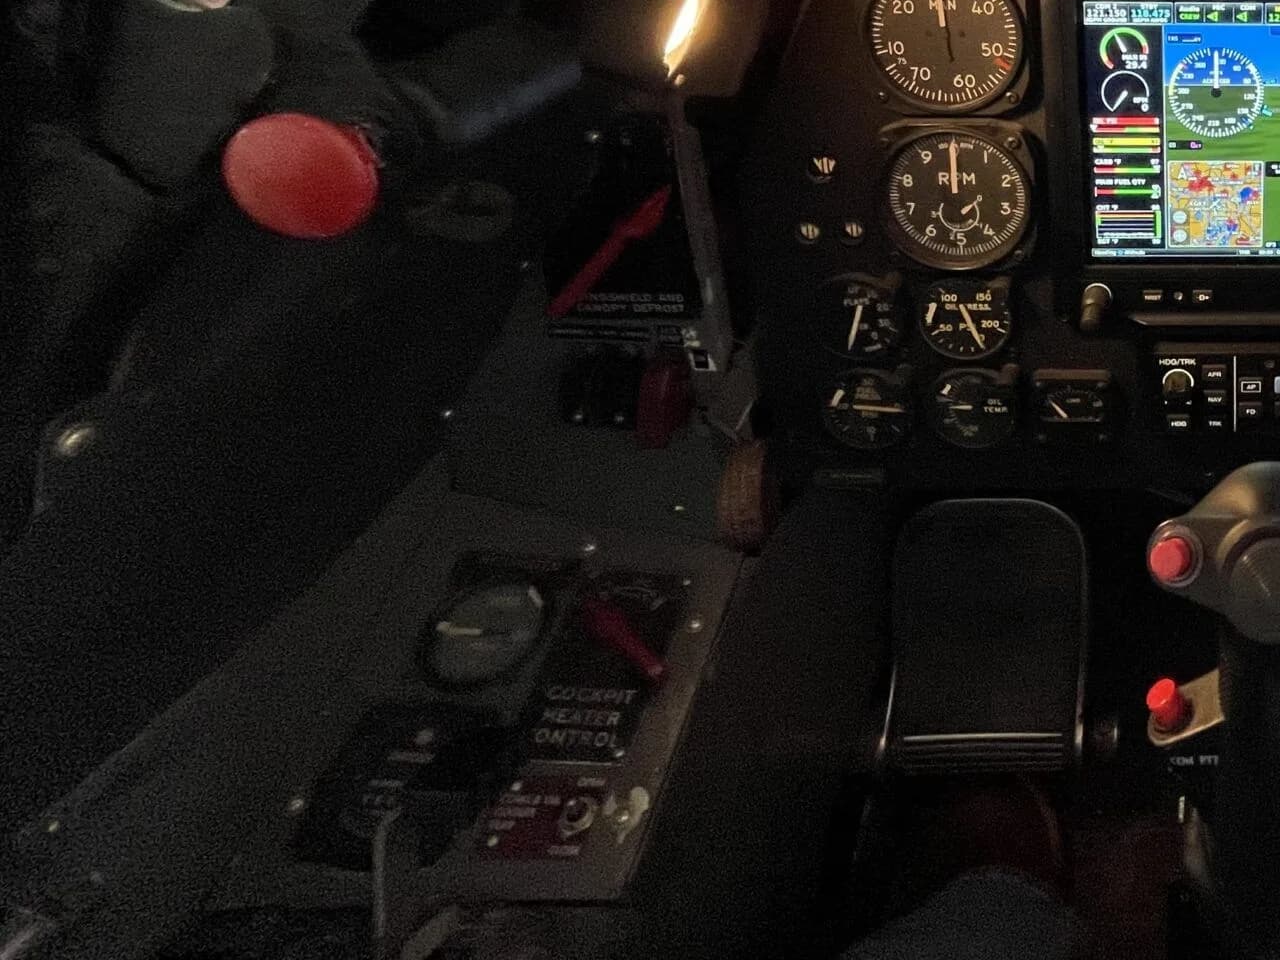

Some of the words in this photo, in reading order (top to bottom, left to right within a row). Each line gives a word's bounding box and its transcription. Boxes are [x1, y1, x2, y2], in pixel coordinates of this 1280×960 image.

[892, 0, 916, 14] 20
[971, 1, 996, 16] 40
[1086, 9, 1127, 18] 121.150
[1130, 9, 1171, 18] 118.475
[887, 40, 905, 56] 10
[980, 42, 1004, 58] 50
[1125, 60, 1148, 70] 29.4
[909, 66, 932, 81] 70
[953, 73, 976, 88] 60
[919, 149, 933, 165] 9
[982, 149, 989, 164] 1
[901, 174, 915, 188] 8
[937, 171, 977, 186] RM
[1000, 174, 1012, 189] 2
[905, 201, 917, 216] 7
[999, 201, 1012, 216] 3
[924, 223, 938, 238] 6
[982, 223, 996, 237] 4
[956, 232, 967, 246] 5
[940, 293, 959, 303] 100
[975, 292, 993, 302] 150
[939, 322, 953, 332] 50
[980, 319, 1000, 329] 200
[1158, 358, 1197, 366] HDG/TRK
[1206, 370, 1223, 378] APR
[1170, 420, 1187, 428] HDG
[547, 685, 638, 705] COCKPIT
[541, 707, 621, 726] HEATER
[533, 727, 618, 749] ONTROL
